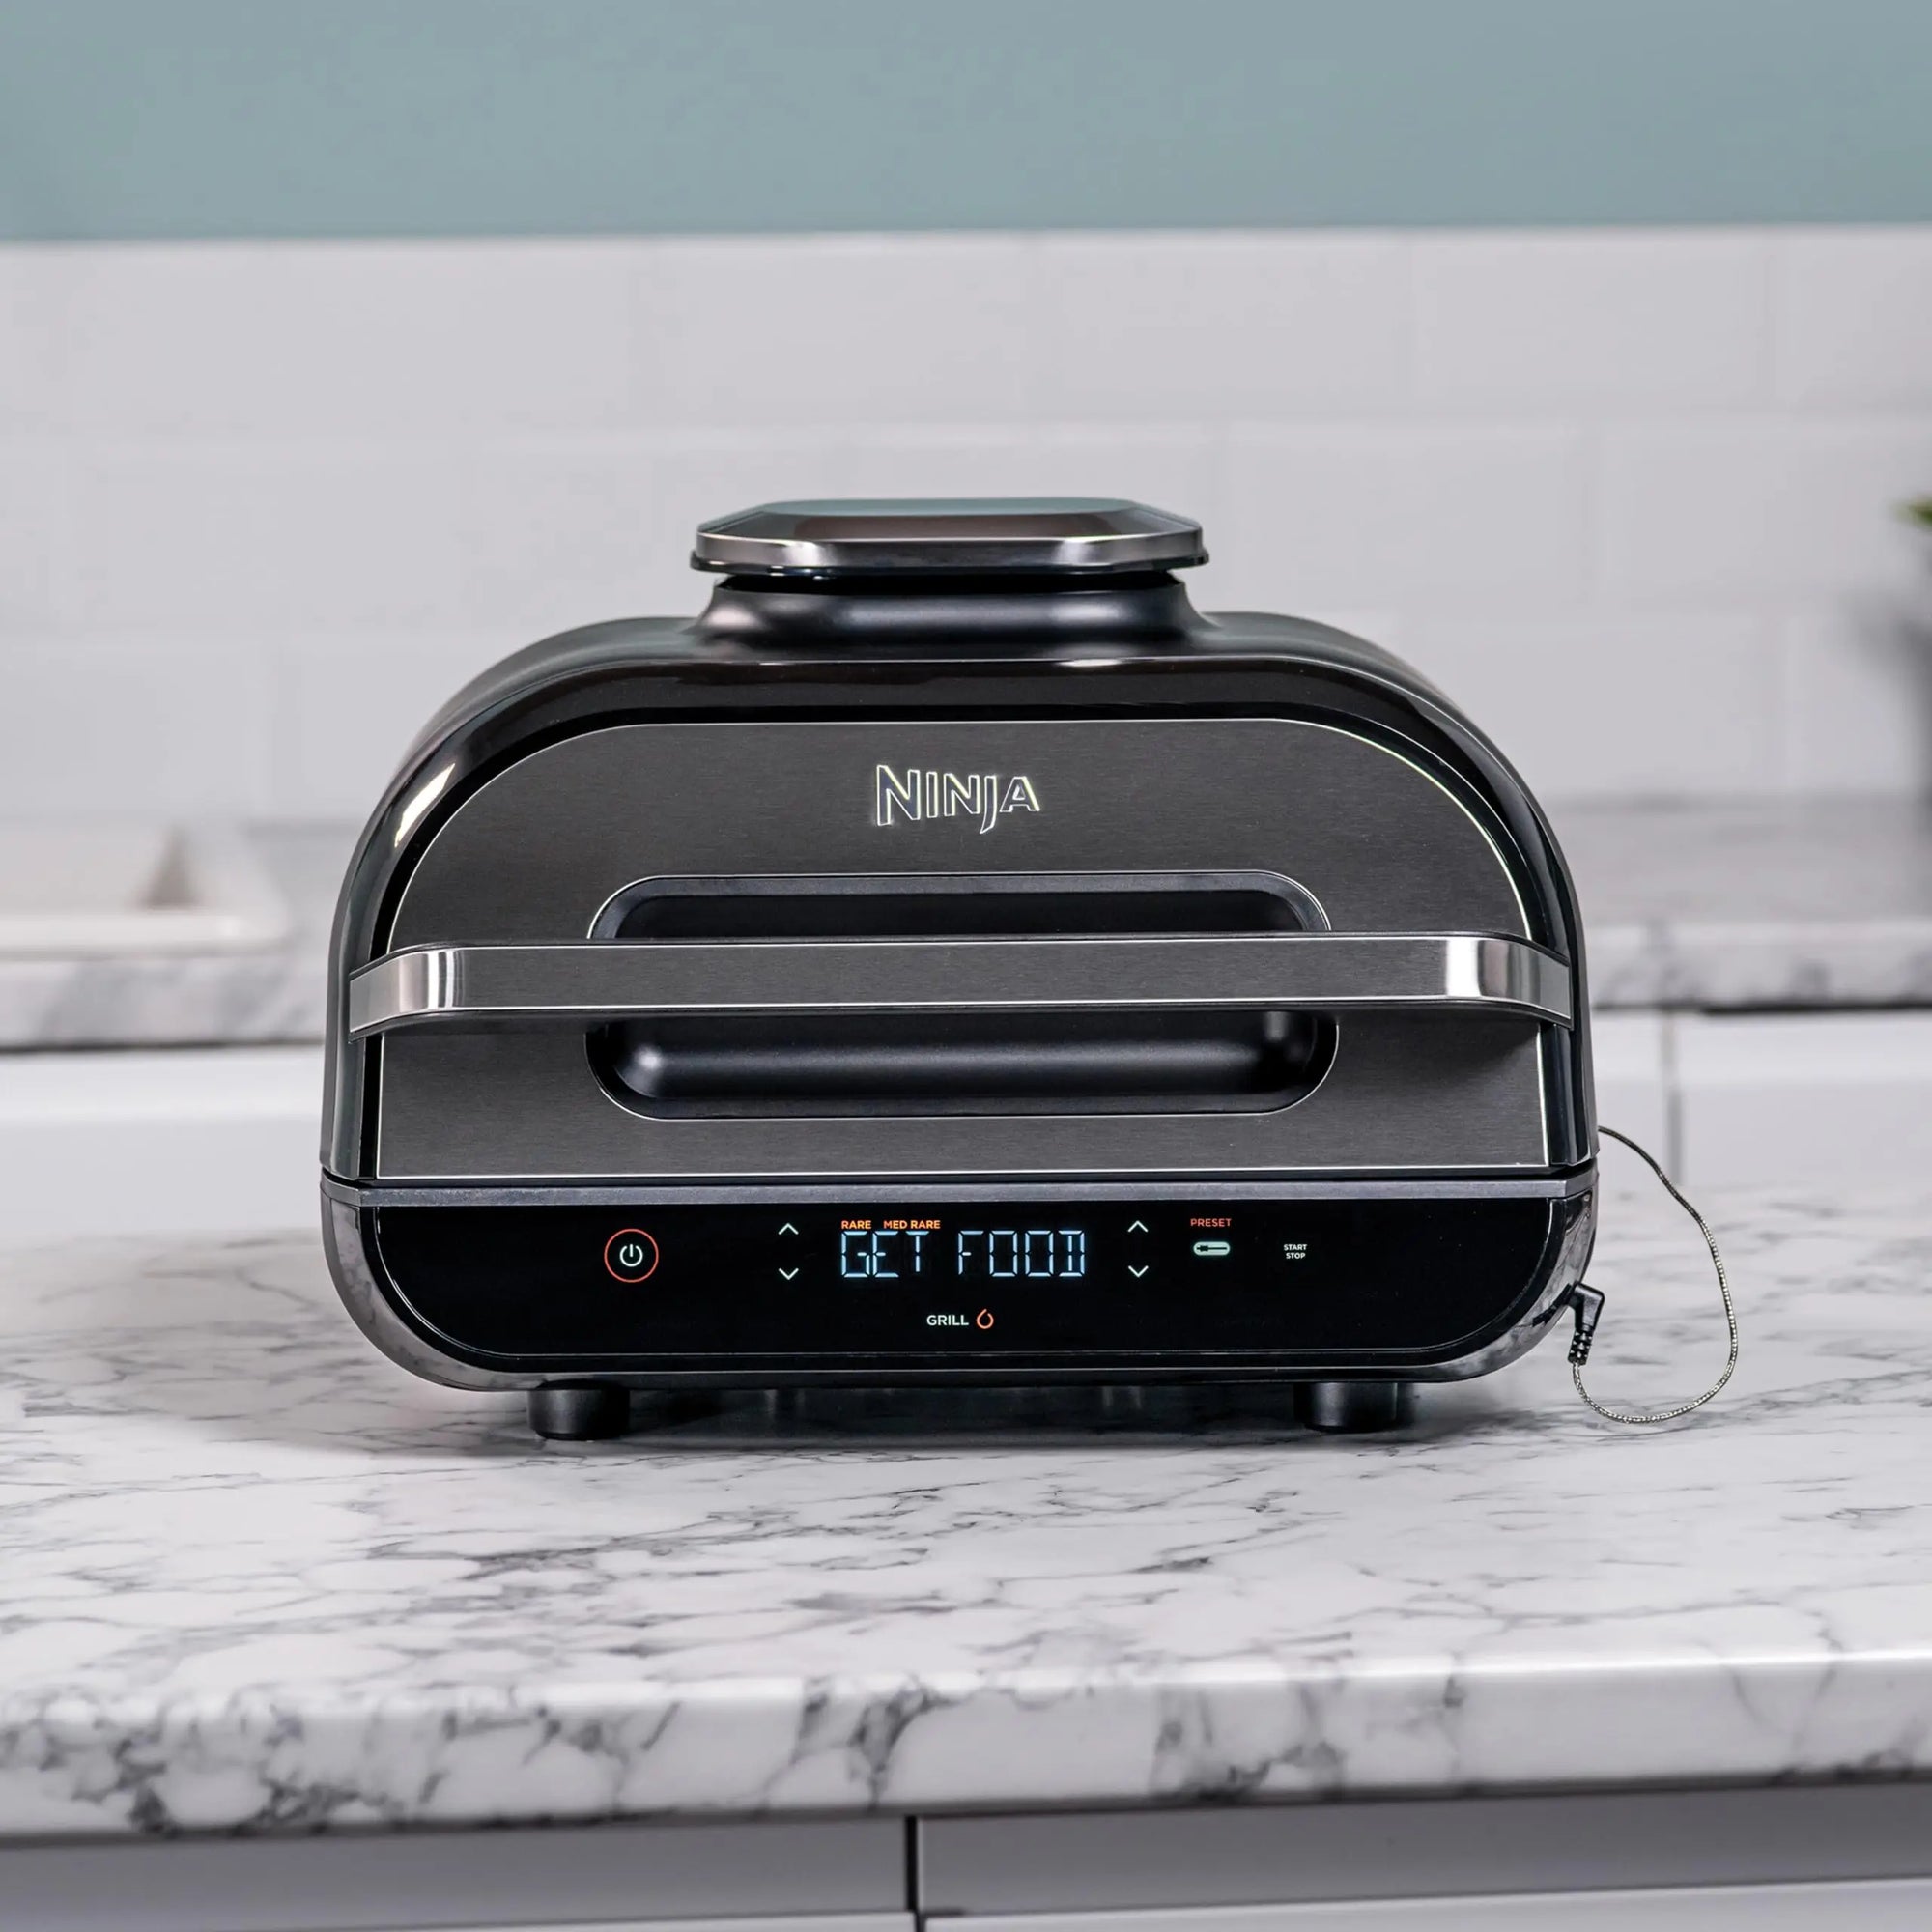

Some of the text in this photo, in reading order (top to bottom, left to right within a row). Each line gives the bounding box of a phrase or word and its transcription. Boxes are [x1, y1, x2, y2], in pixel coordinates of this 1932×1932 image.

[876, 764, 1040, 835] NINJA
[840, 1220, 872, 1230] RARE
[883, 1220, 941, 1230] MED RARE
[1190, 1218, 1232, 1227] PRESET
[840, 1230, 1086, 1278] GET FOOD
[926, 1314, 970, 1326] GRILL
